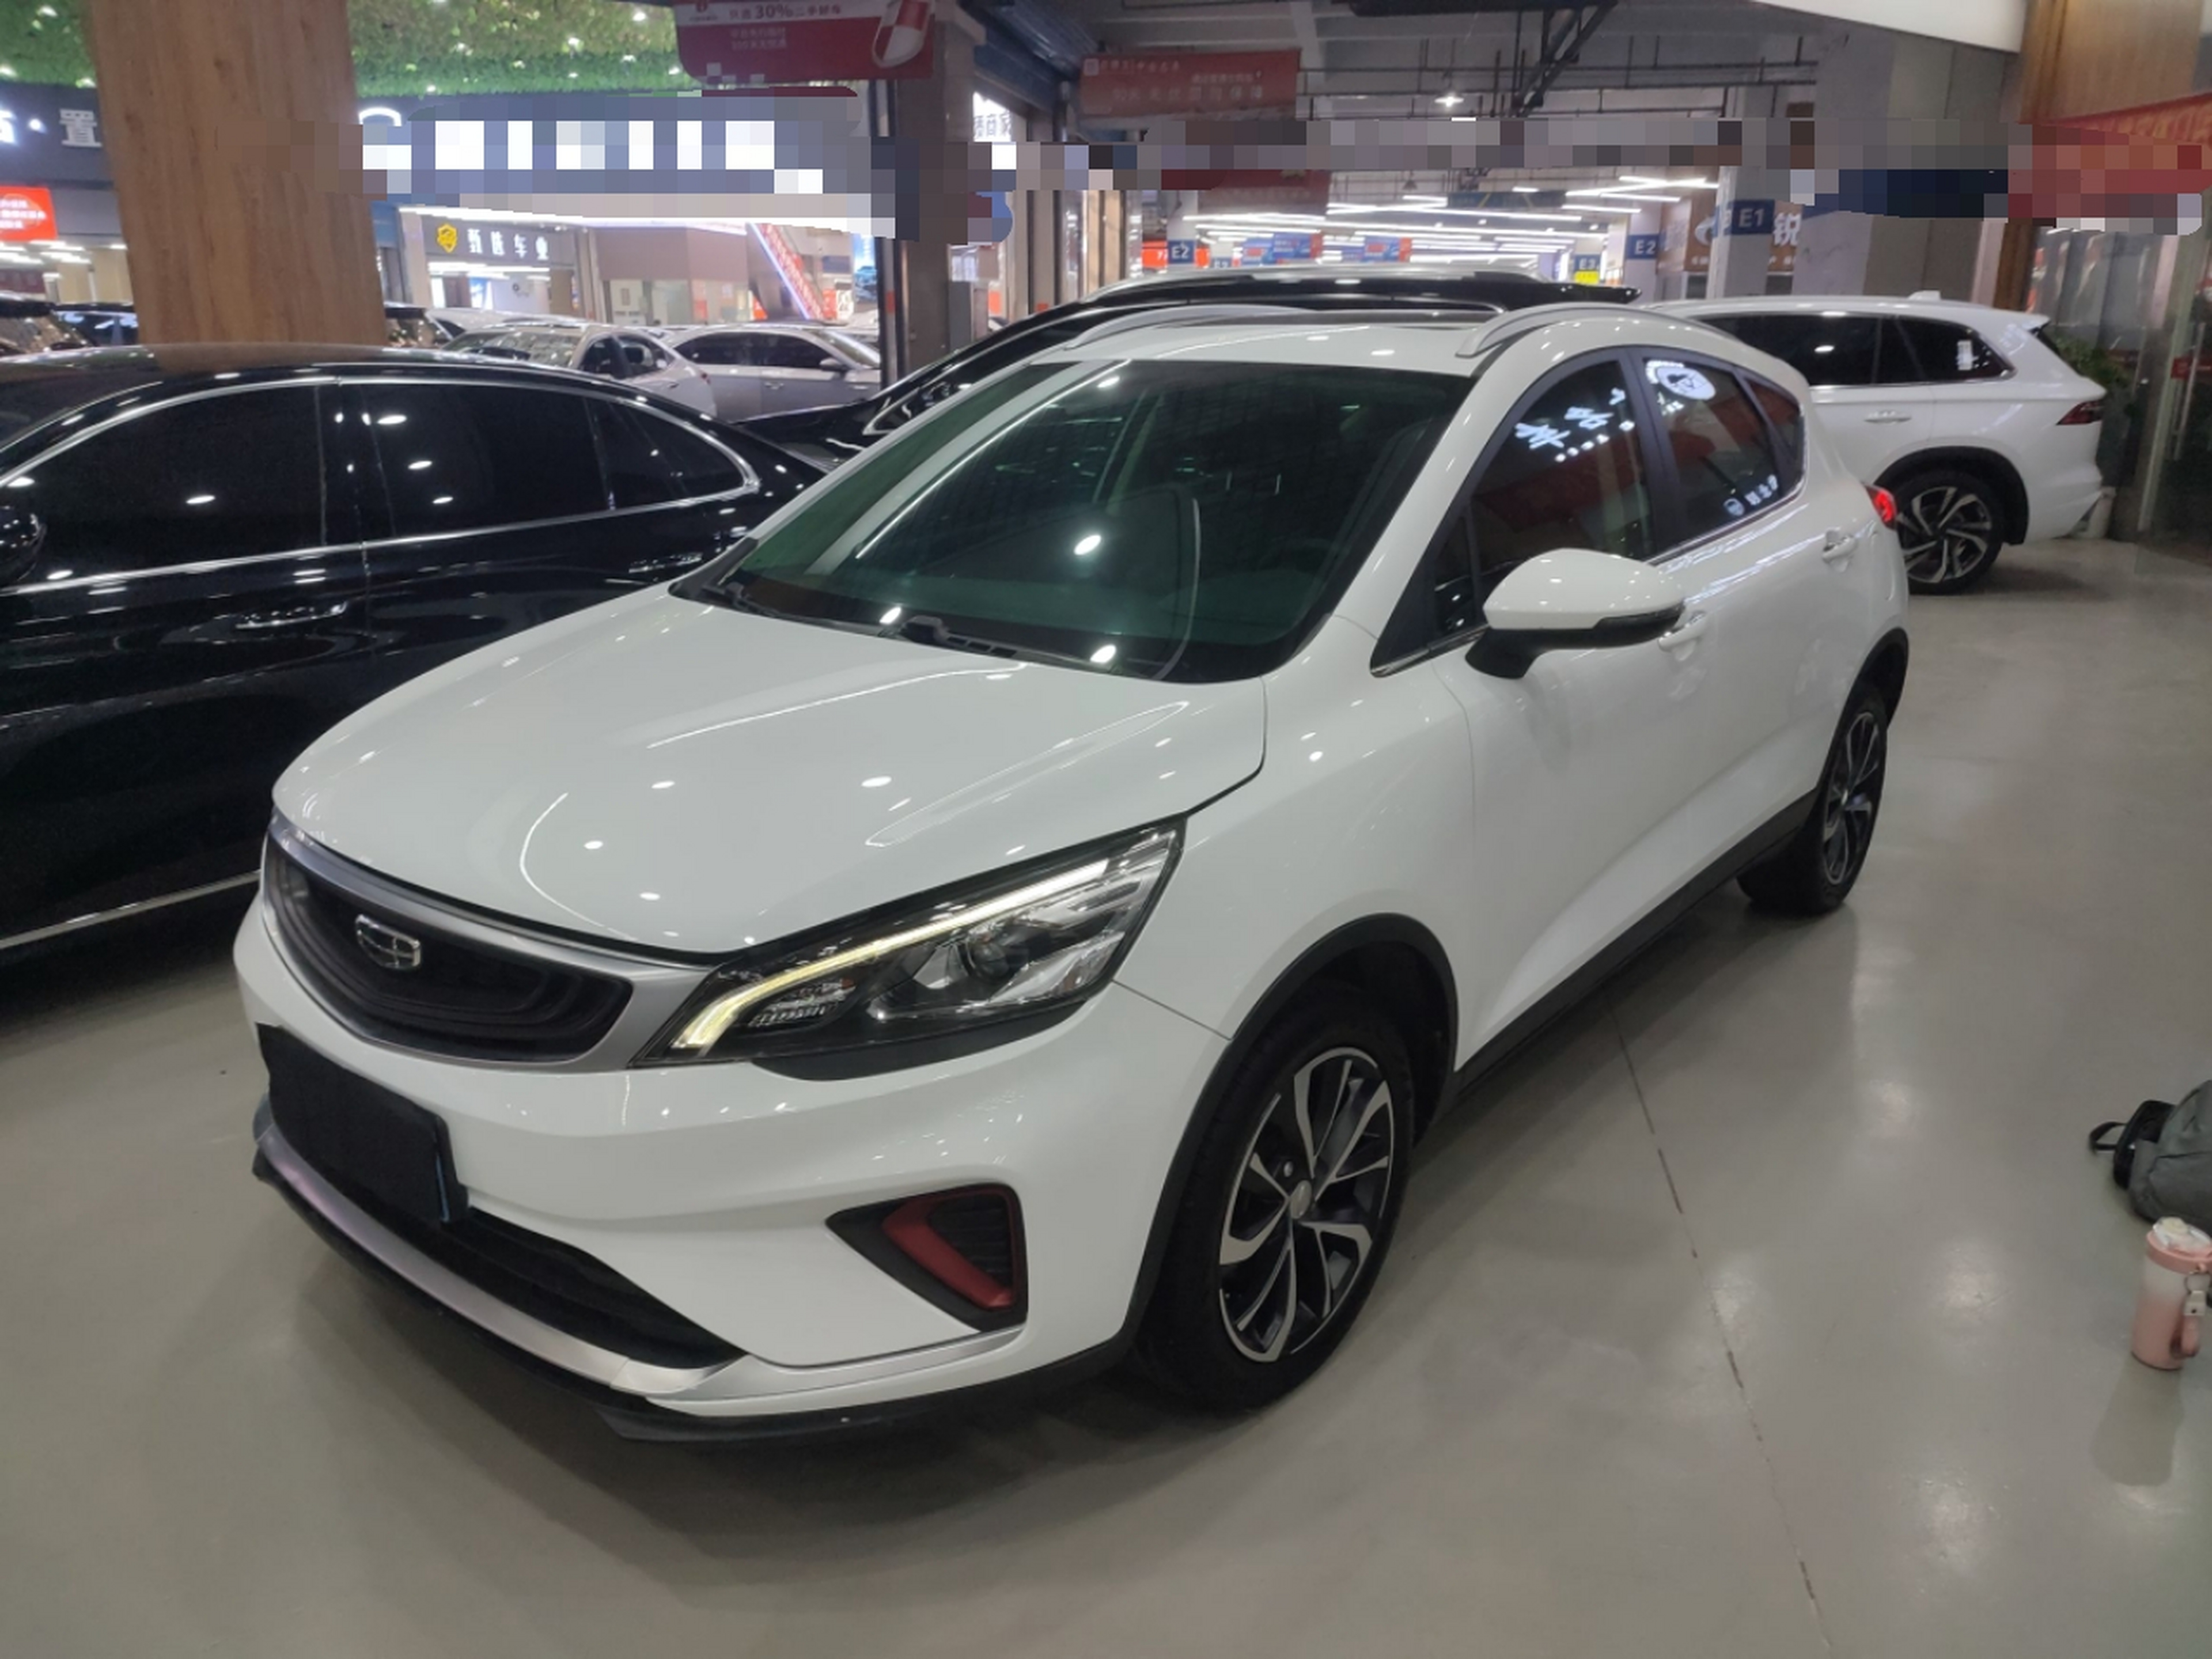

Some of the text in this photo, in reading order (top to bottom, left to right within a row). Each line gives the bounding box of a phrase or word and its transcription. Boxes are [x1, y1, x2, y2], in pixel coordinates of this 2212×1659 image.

[1738, 208, 1764, 228] E1
[1172, 244, 1191, 259] E2
[1635, 240, 1657, 255] E2
